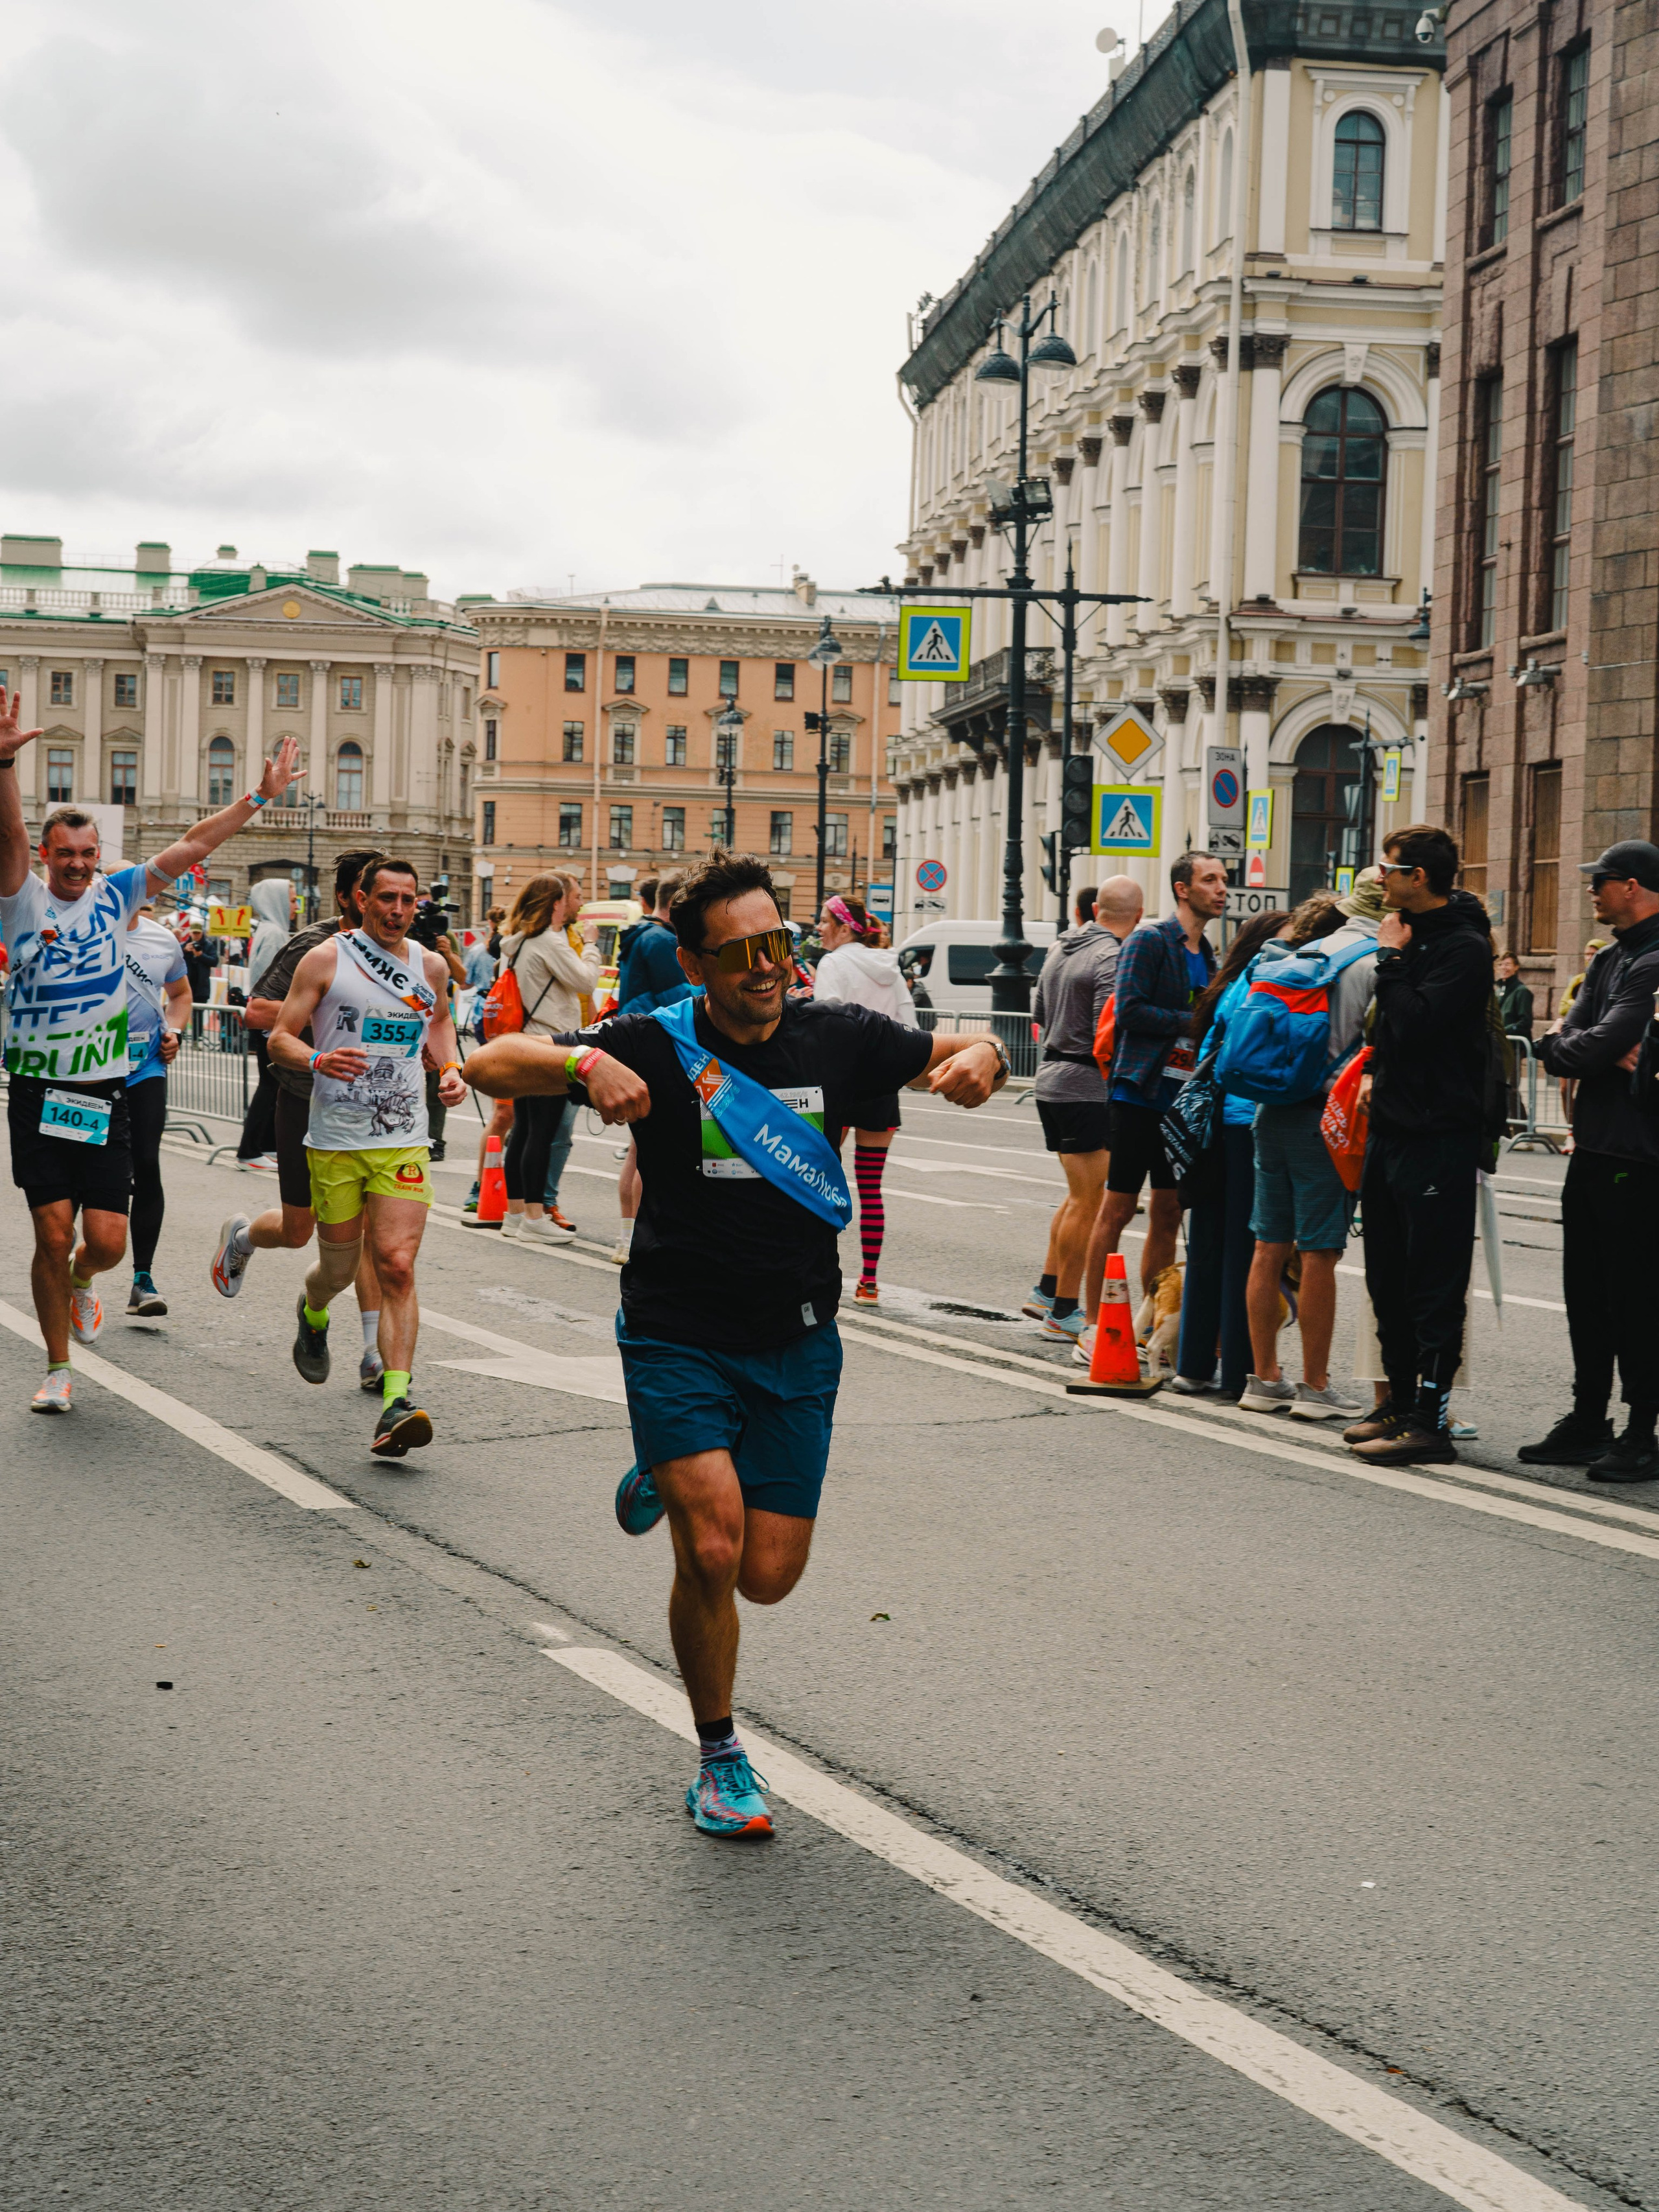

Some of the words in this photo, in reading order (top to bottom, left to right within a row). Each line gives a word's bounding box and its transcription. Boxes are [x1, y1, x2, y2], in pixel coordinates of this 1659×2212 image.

[1215, 752, 1236, 762] ЗОНА
[387, 1011, 421, 1019] ЭКИДЕ
[369, 1023, 418, 1042] 355-4
[66, 1097, 104, 1110] ЭКИДЕН
[51, 1106, 99, 1131] 140-4
